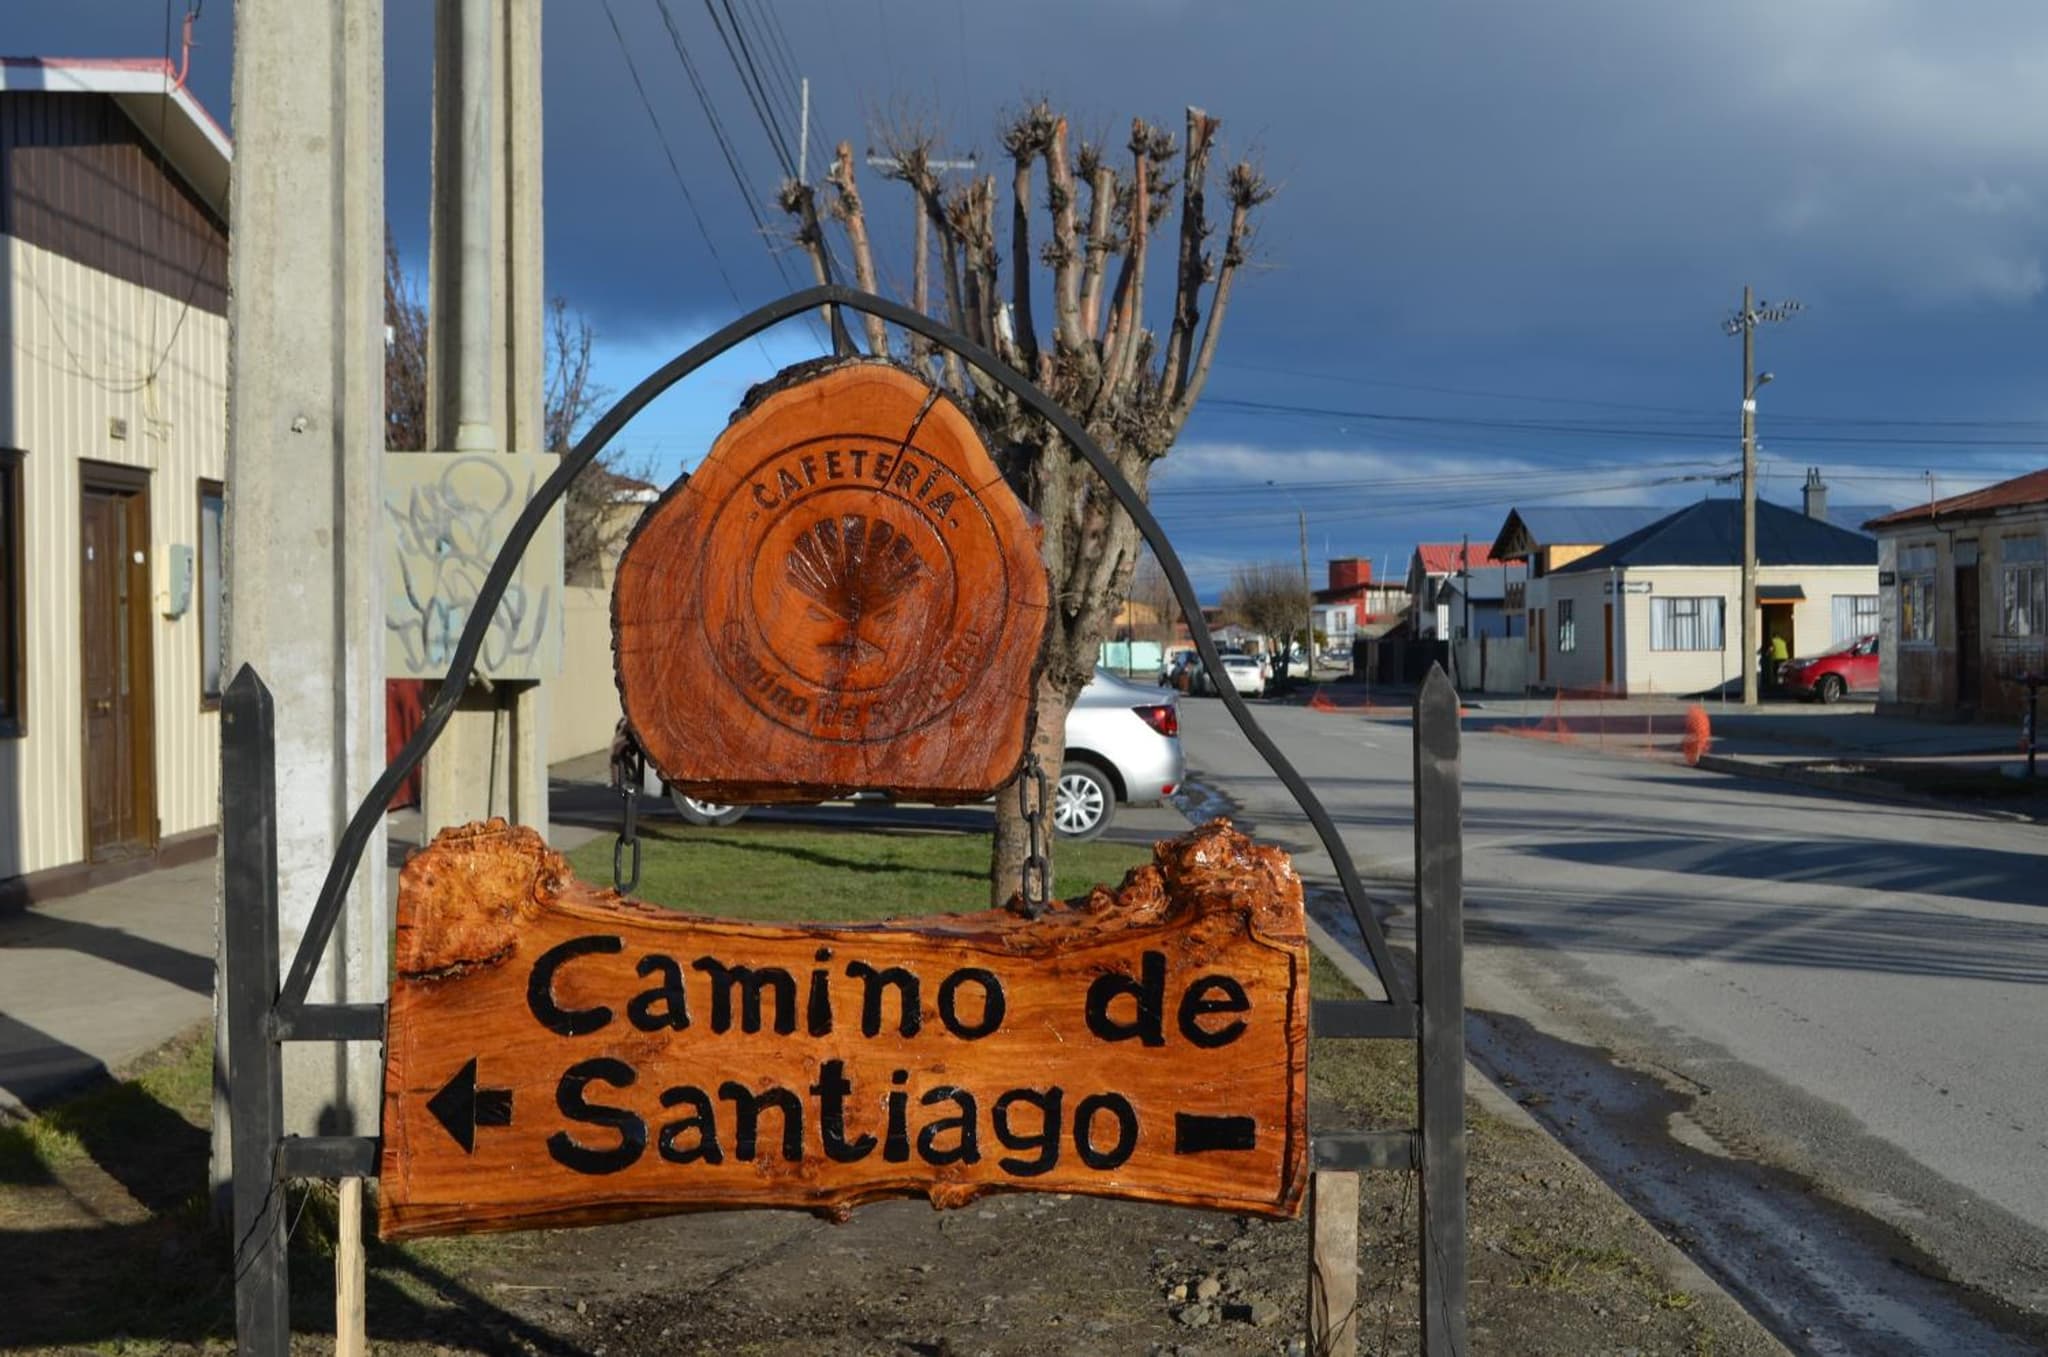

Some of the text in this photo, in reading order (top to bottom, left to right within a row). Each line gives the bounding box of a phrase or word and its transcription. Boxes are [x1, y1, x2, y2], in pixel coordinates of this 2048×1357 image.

[527, 934, 1251, 1048] Camino de
[546, 1057, 1140, 1177] Santiago
